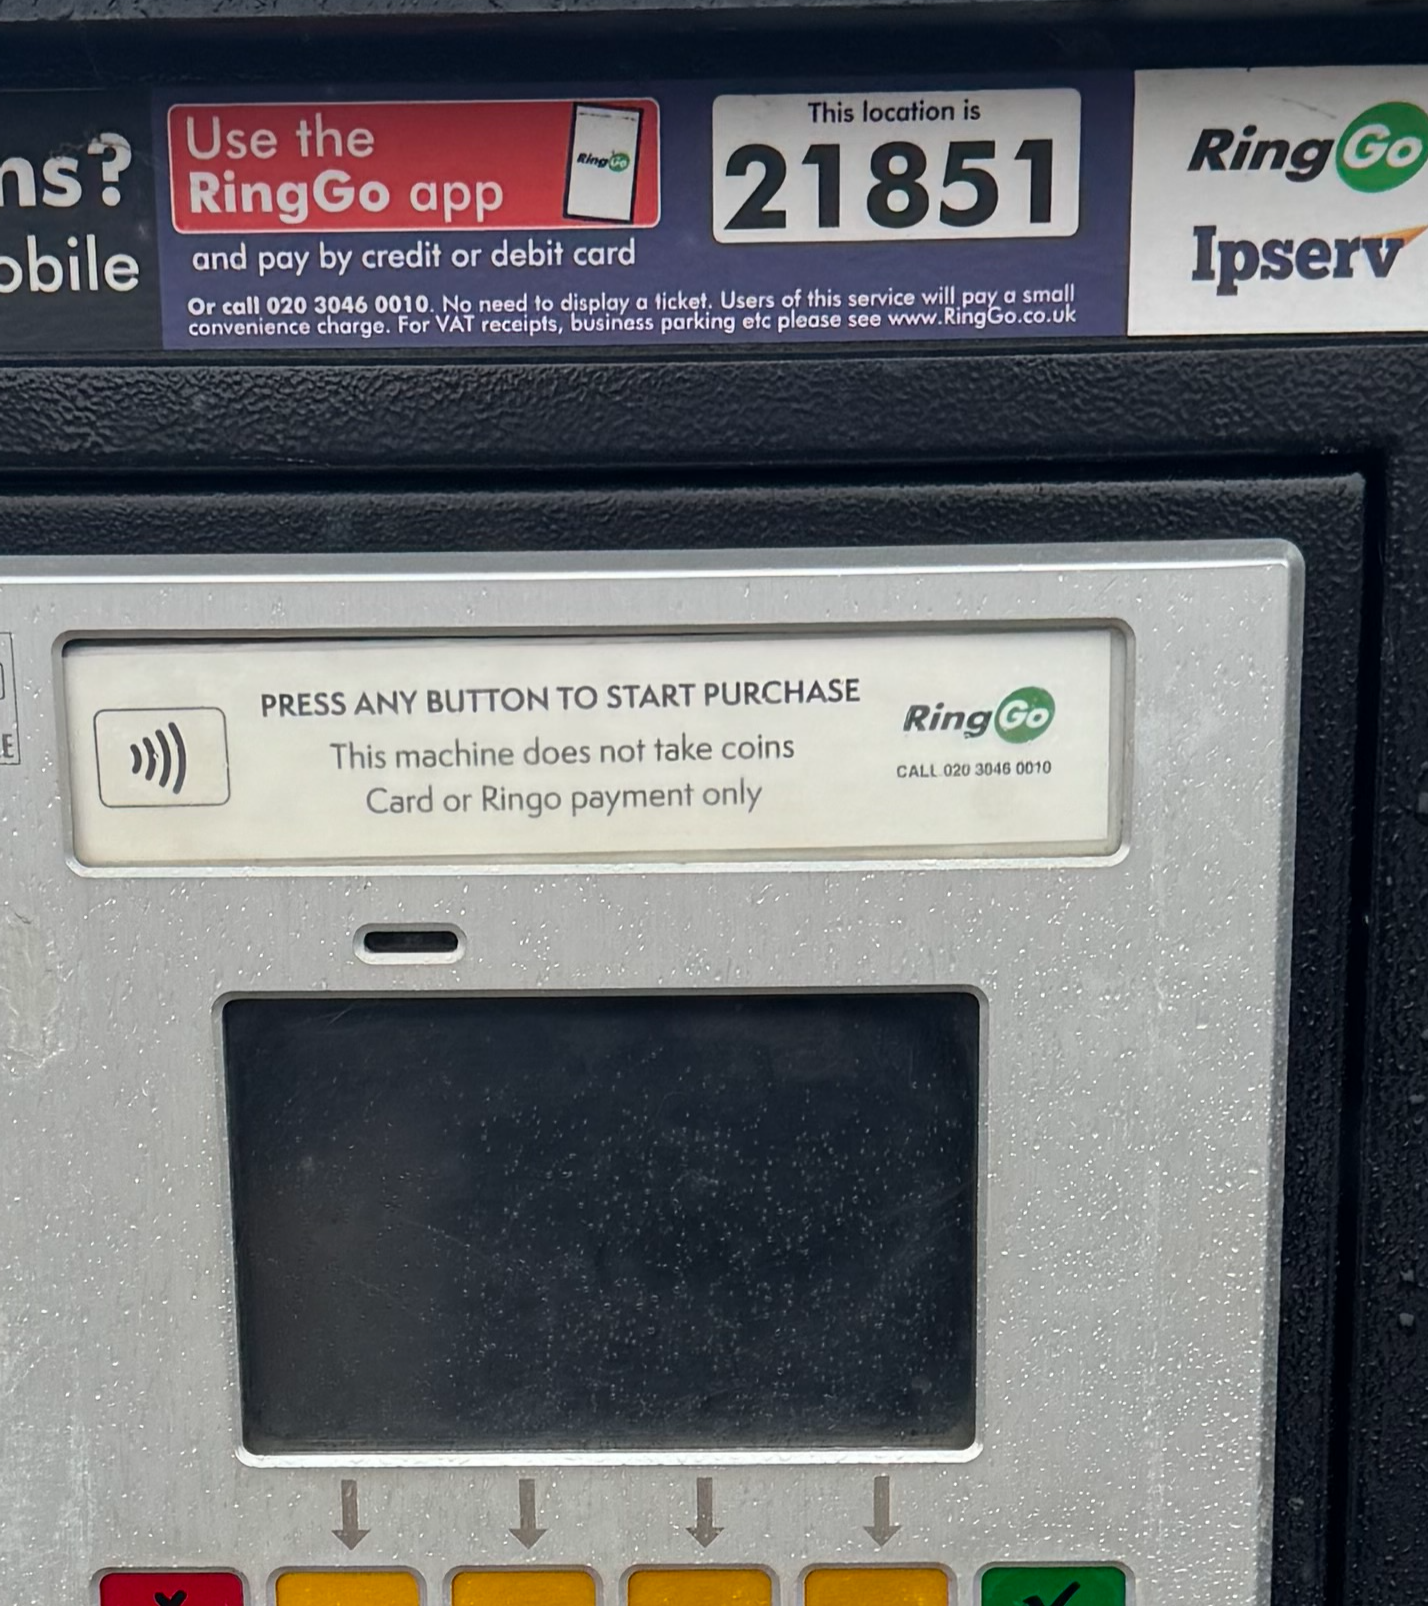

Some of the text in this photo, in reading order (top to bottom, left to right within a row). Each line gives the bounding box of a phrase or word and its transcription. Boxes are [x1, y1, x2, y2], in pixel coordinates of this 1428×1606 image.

[808, 98, 981, 123] This location is
[186, 113, 375, 160] Use the
[1187, 124, 1422, 183] RingGo
[189, 170, 503, 225] RingGo app
[723, 139, 1053, 231] 21851
[192, 237, 635, 276] and pay by credit or debit card
[1192, 225, 1406, 296] Ipserv
[188, 283, 1075, 318] Or call 020 3046 0010. No need to display a ticket. Users of this service will pay a small
[188, 306, 1077, 338] convenience charge. For VAT receipts, business parking etc please see www.RingGo.co.uk
[261, 678, 860, 717] PRESS ANY BUTTON TO START PURCHASE
[903, 699, 1050, 738] RingGo
[330, 732, 795, 770] This machine does not take coins
[897, 760, 1052, 778] CALL 020 3046 0010
[366, 778, 762, 818] Card or Ringo payment only
